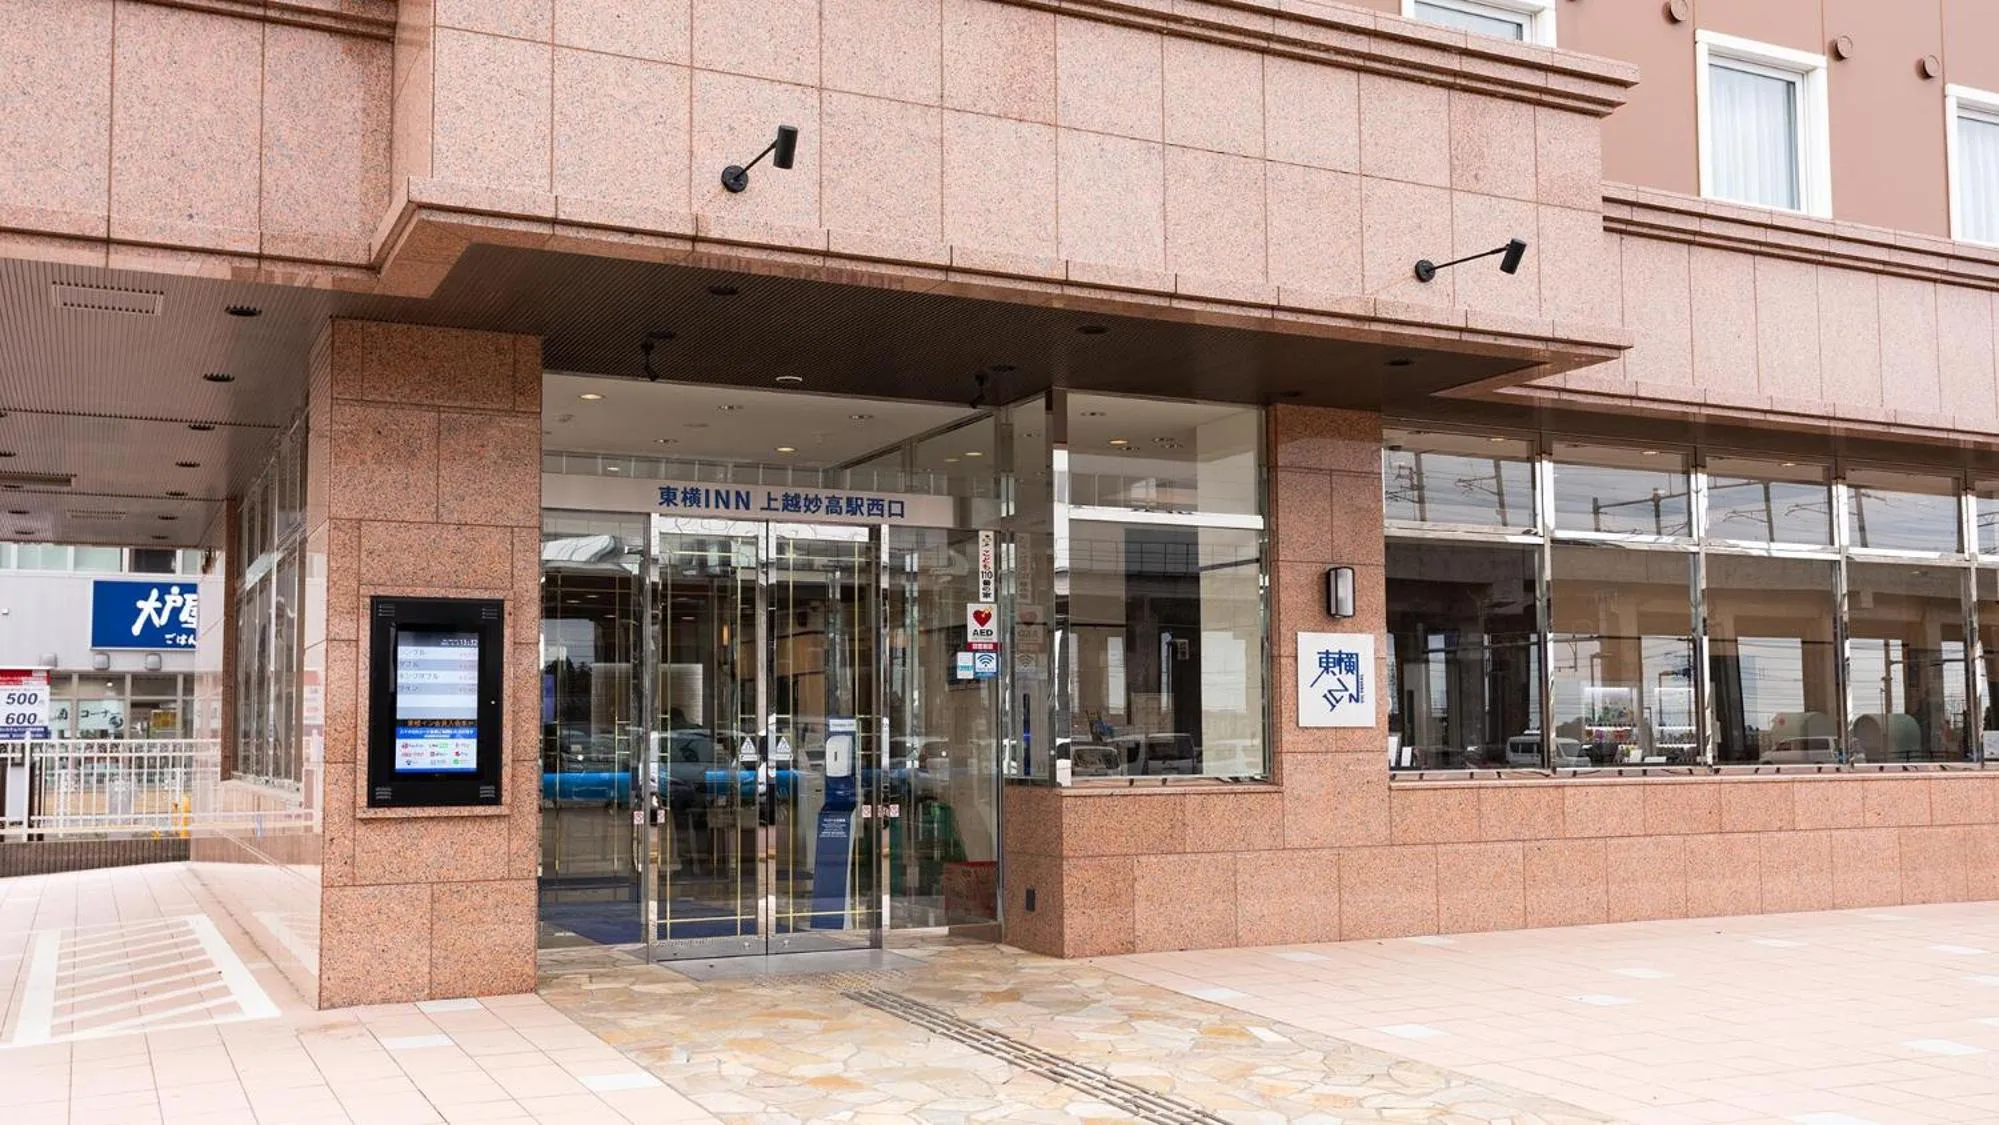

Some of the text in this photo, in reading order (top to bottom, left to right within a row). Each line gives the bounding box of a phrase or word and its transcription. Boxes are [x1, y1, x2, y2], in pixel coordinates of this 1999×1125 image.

[658, 486, 906, 519] 東横INN 上越妙高駅西口
[972, 628, 993, 636] AED
[5, 692, 39, 705] 500
[5, 712, 38, 725] 600
